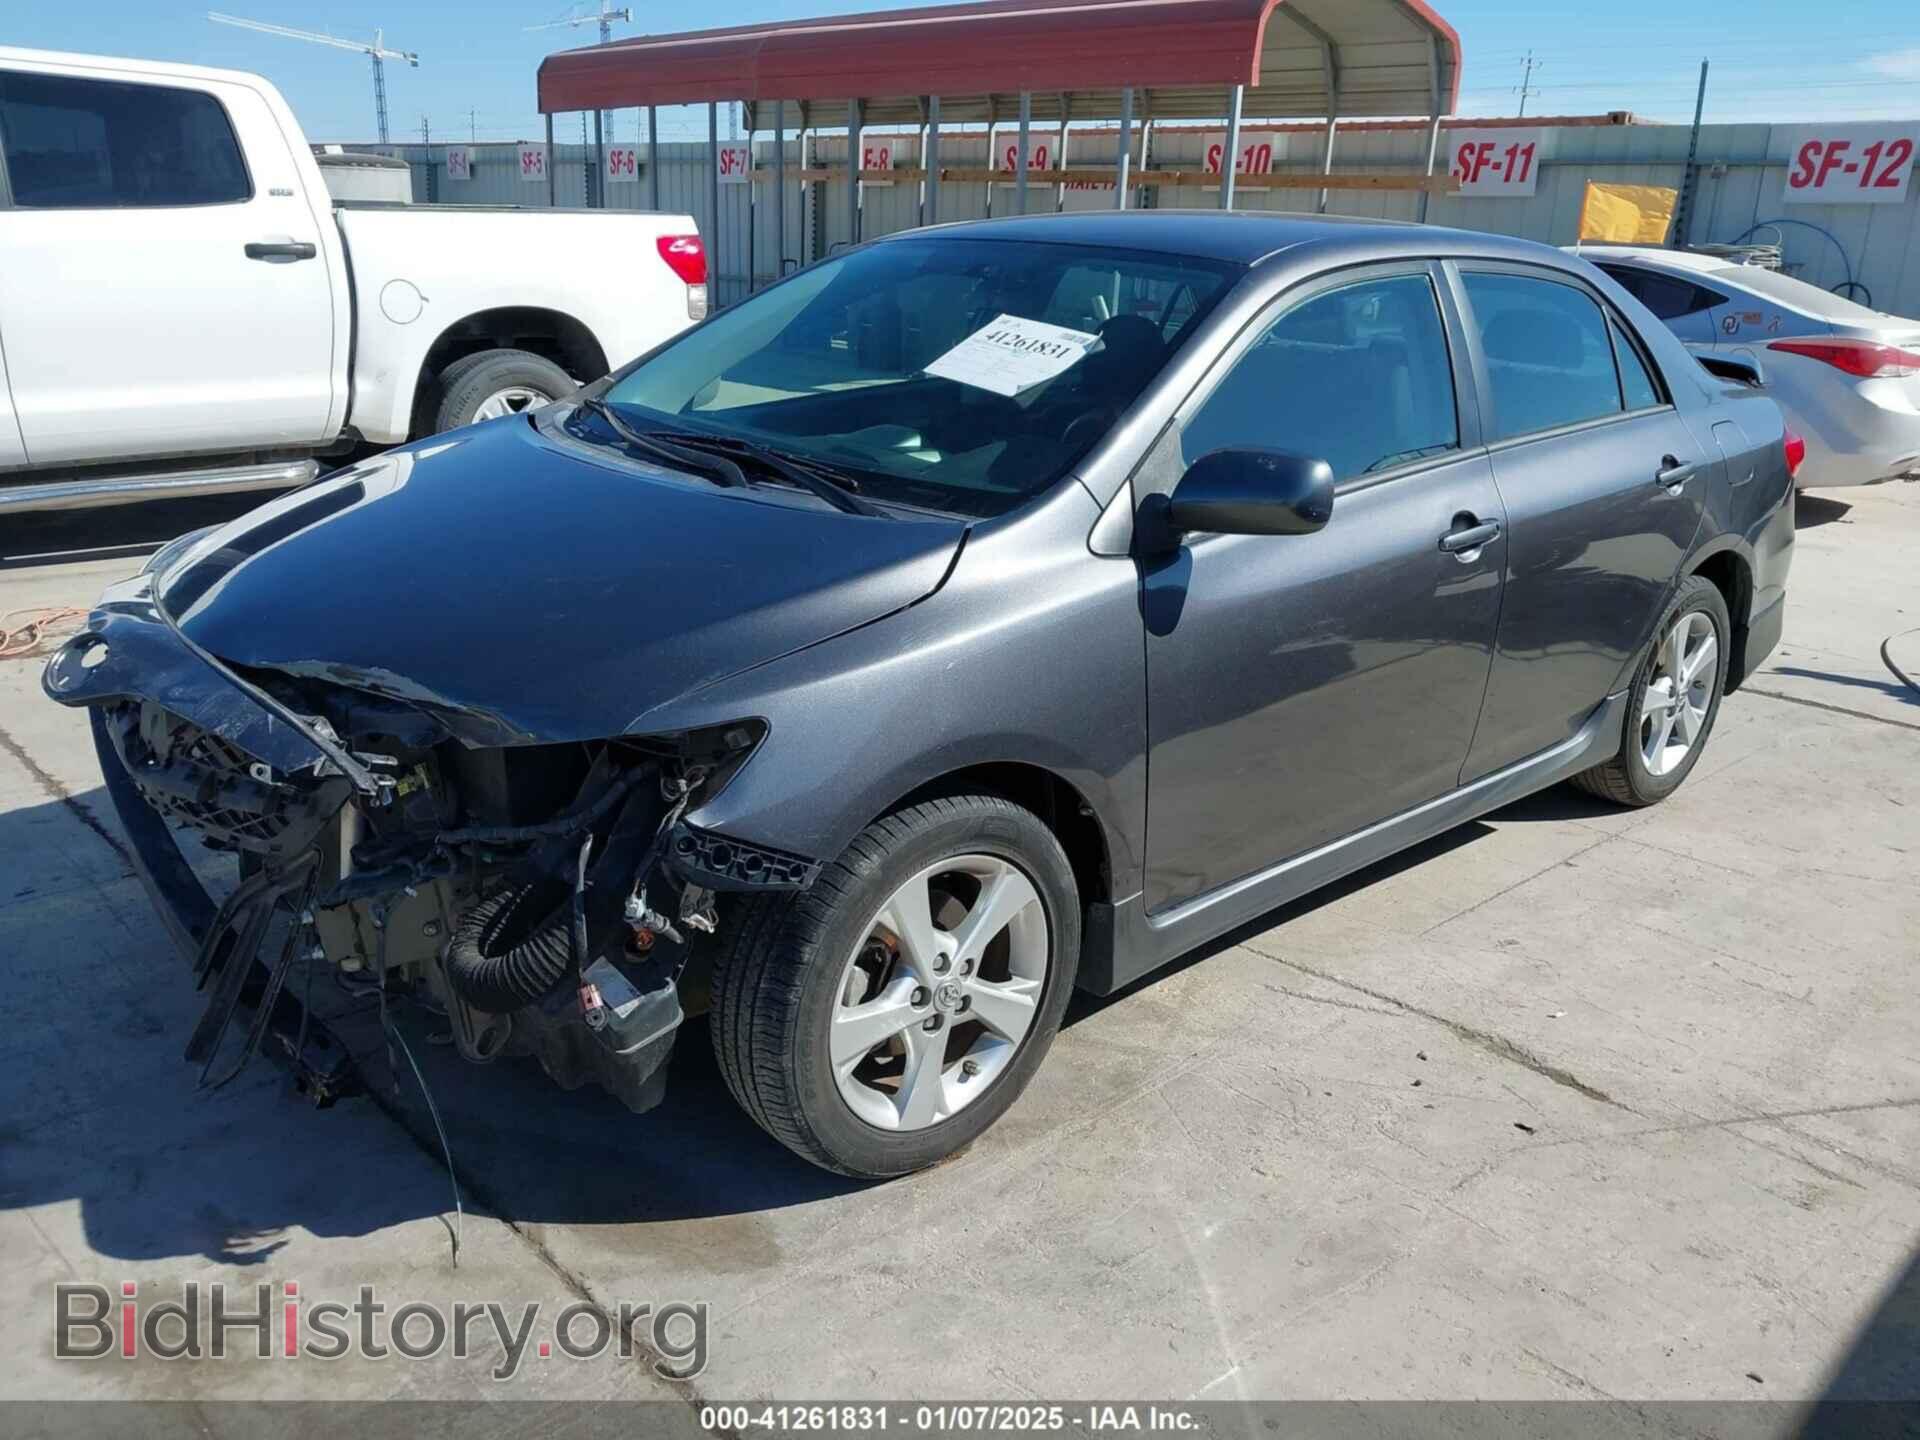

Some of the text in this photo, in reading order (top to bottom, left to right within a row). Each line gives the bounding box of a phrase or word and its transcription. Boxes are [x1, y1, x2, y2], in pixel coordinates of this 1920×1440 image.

[522, 151, 543, 175] SF-5
[609, 149, 635, 175] SF-6
[719, 148, 748, 175] SF-7
[863, 146, 889, 170] F-8
[1006, 145, 1048, 171] S-9
[1205, 143, 1272, 176] S-10
[1452, 141, 1536, 183] SF-11
[1789, 138, 1913, 189] SF-12
[985, 329, 1072, 359] 41261831
